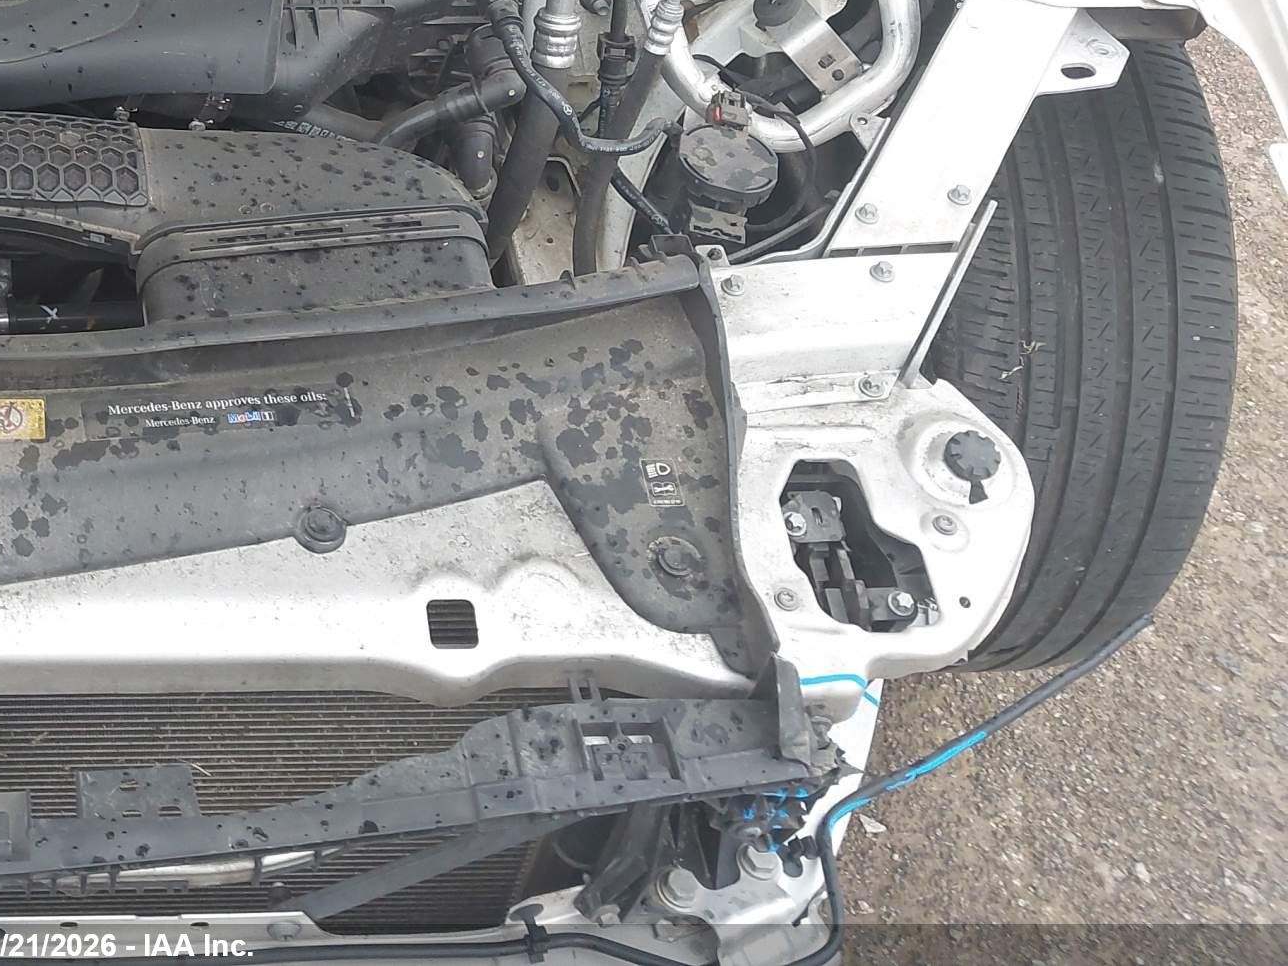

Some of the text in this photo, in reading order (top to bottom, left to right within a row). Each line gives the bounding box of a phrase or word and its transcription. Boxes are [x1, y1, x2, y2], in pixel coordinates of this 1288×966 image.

[108, 391, 328, 415] Mercedes-Benz approves these oils:
[145, 415, 216, 428] Mercedes-Benz
